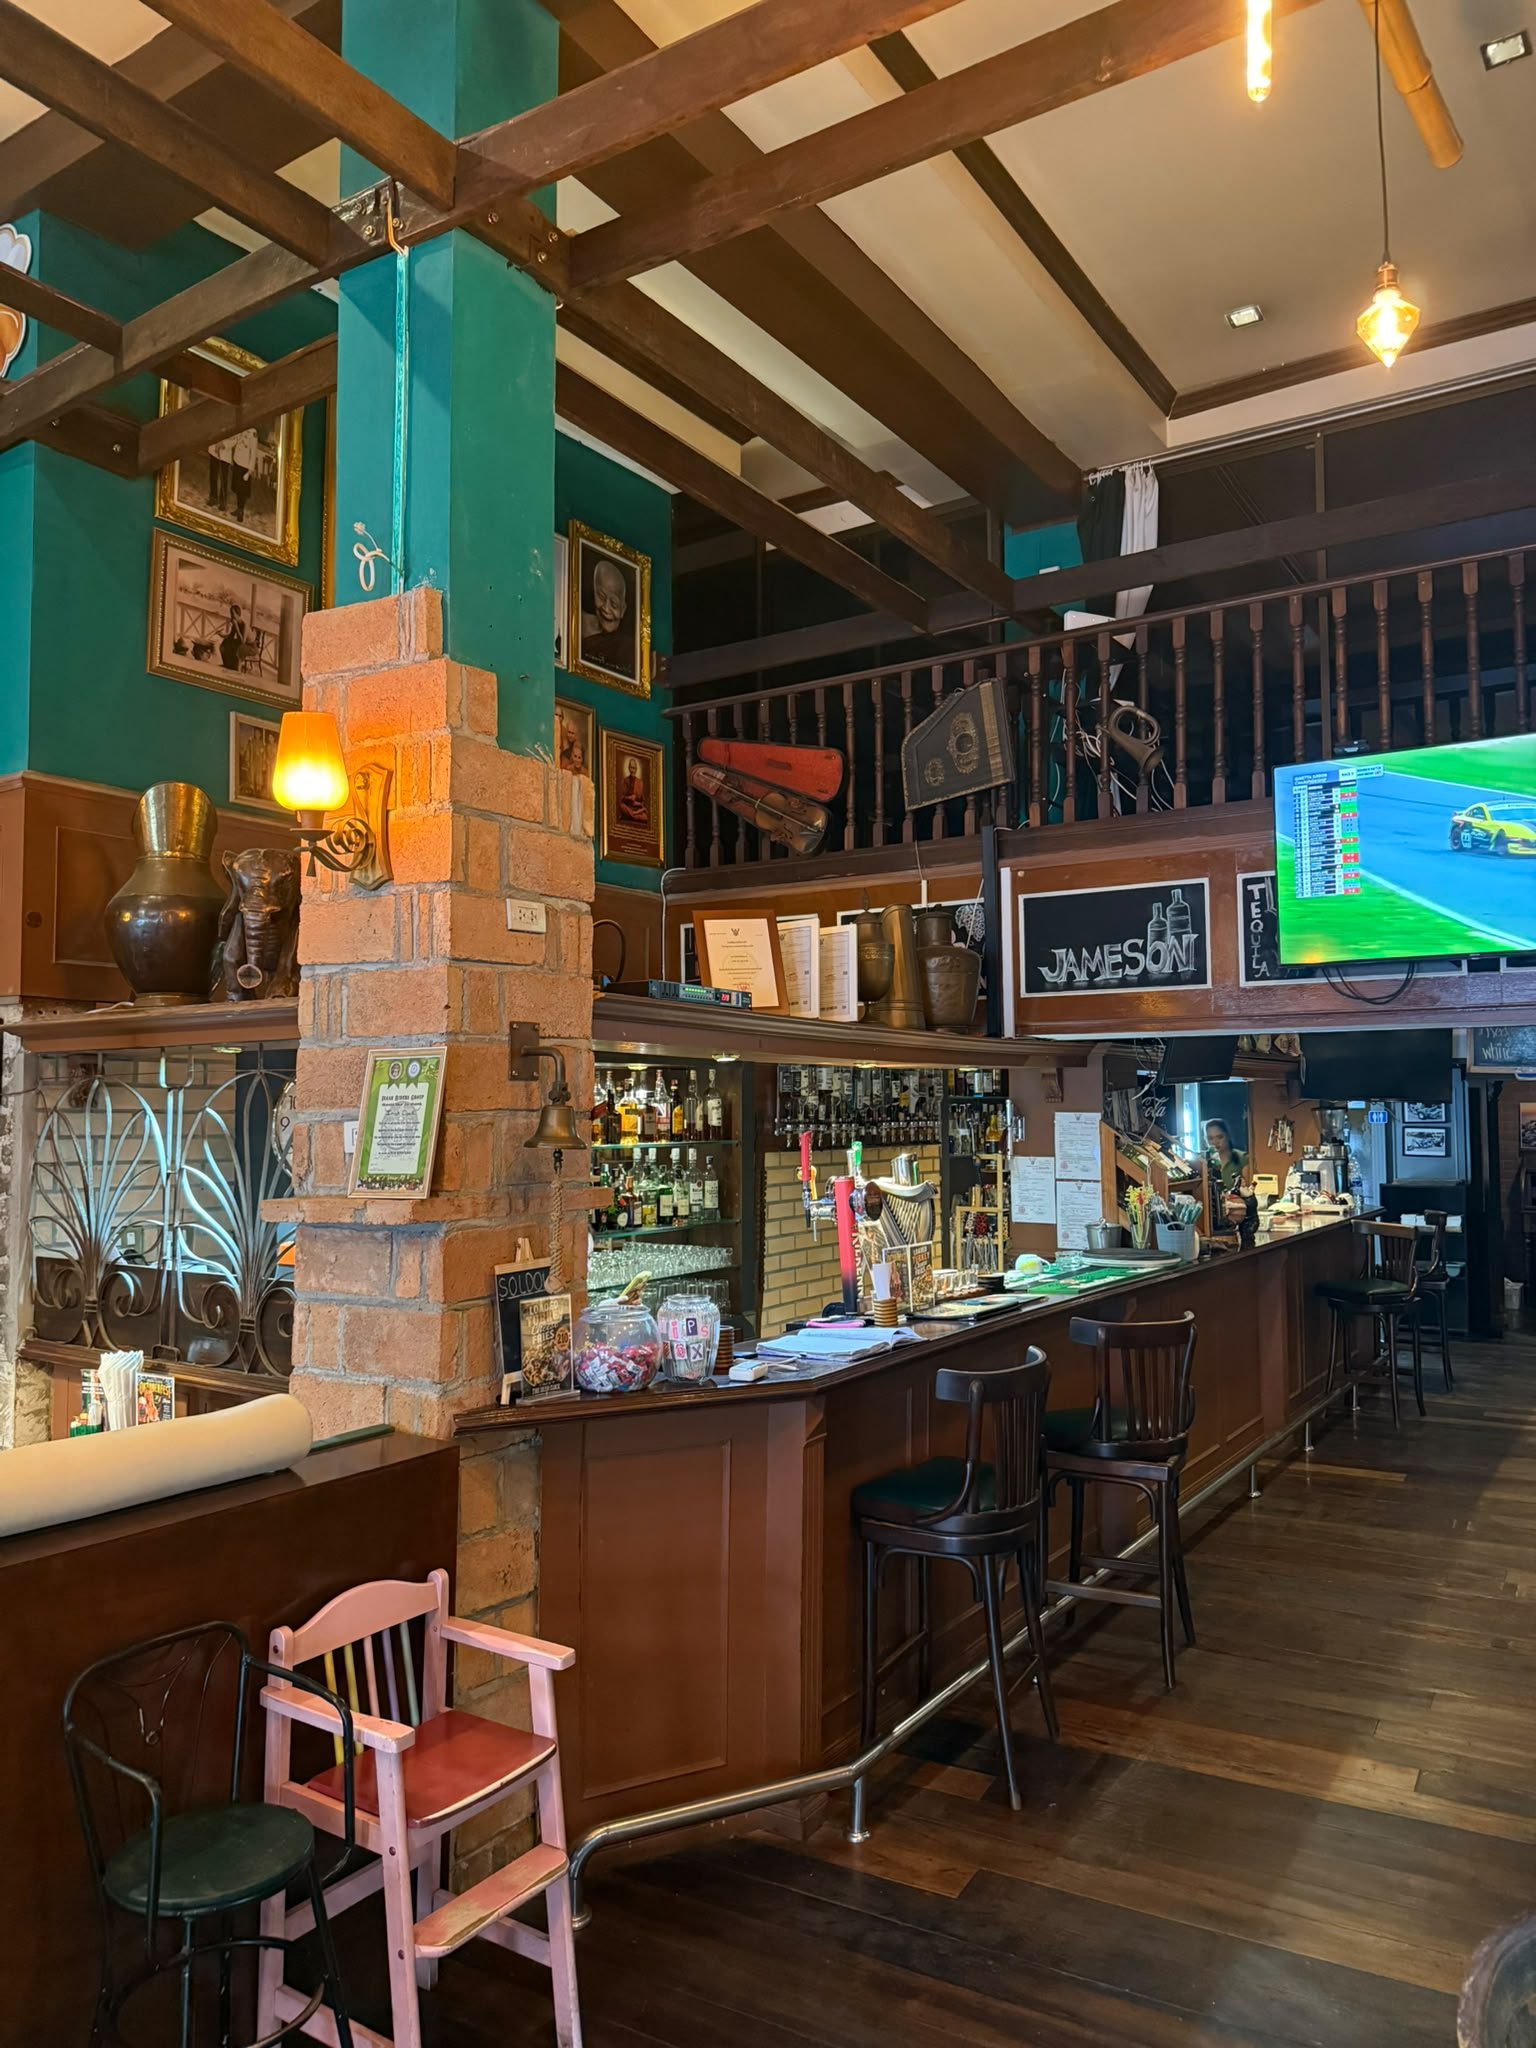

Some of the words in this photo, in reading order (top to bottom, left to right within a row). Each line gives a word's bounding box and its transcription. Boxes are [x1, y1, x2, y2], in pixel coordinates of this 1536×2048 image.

[1246, 883, 1270, 978] TEQUILA
[1037, 933, 1199, 983] JAMESON
[532, 1330, 555, 1345] FRIES
